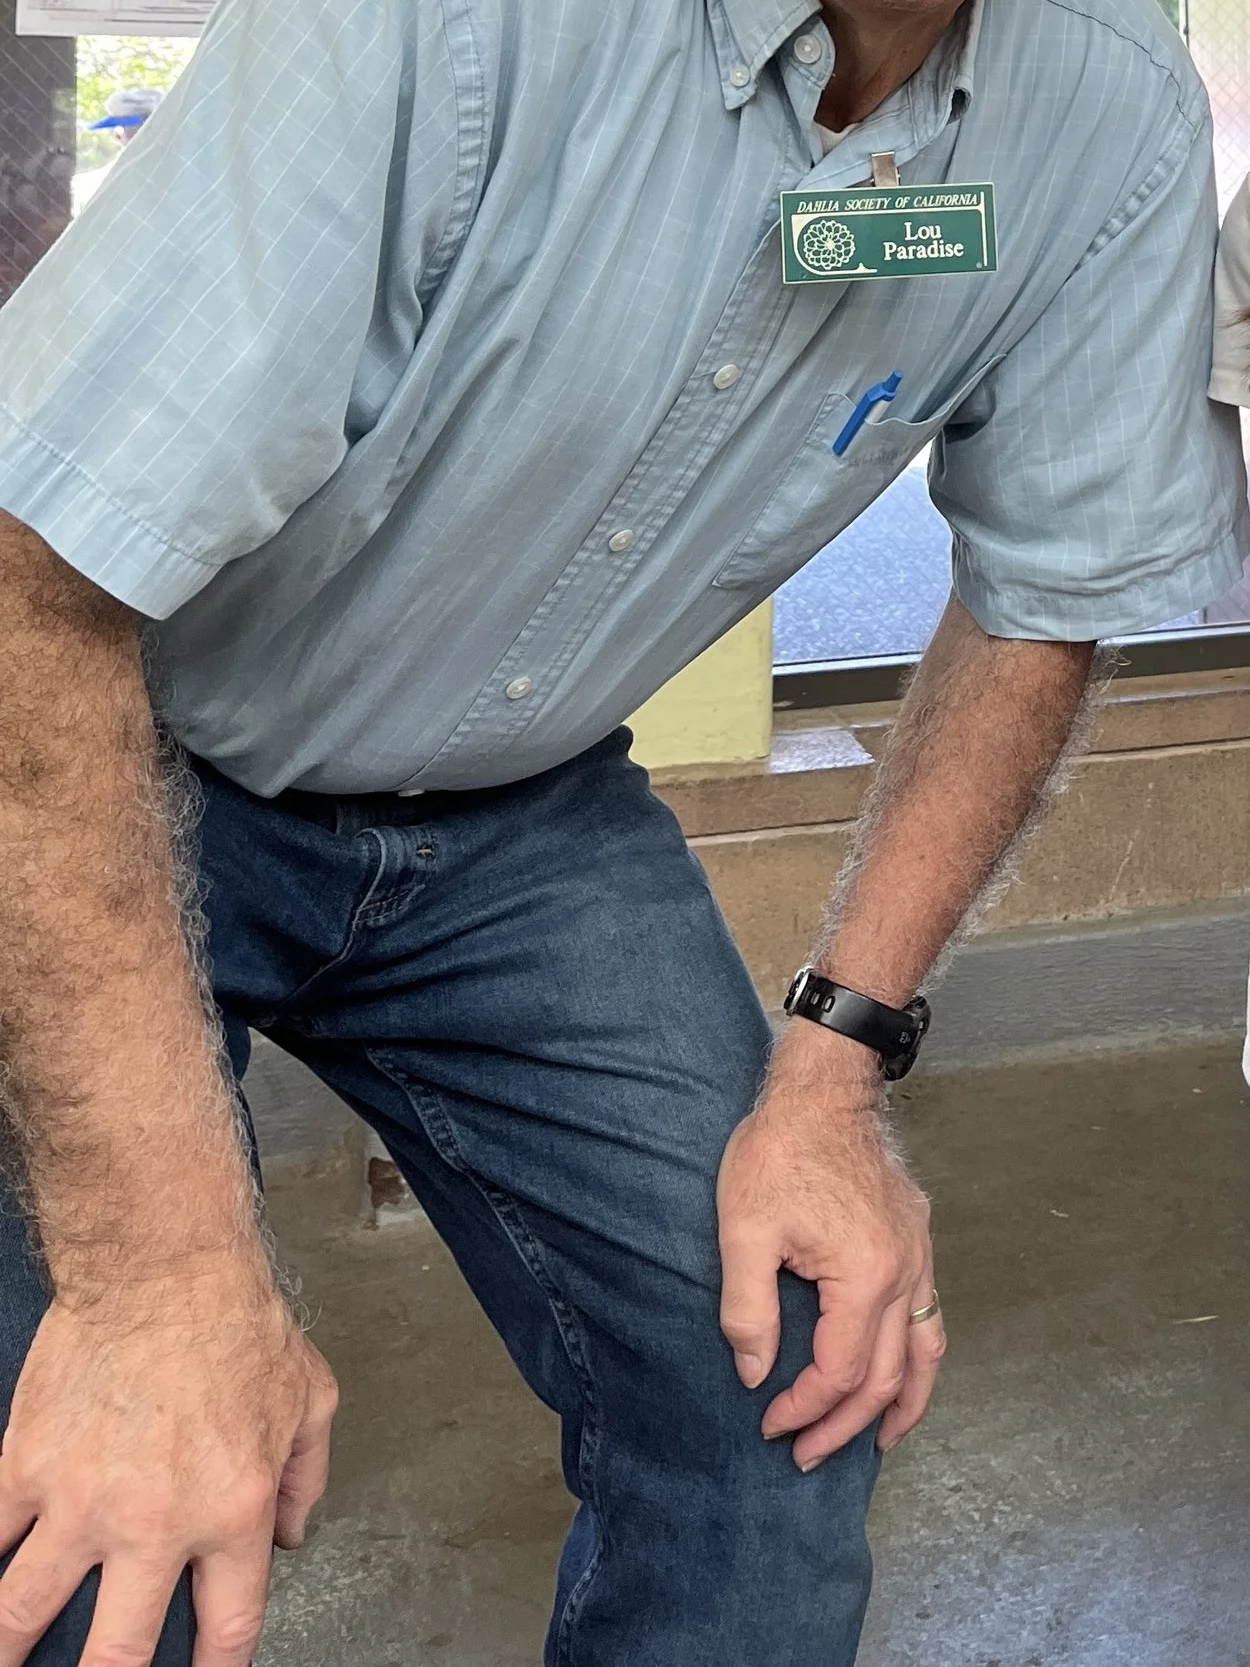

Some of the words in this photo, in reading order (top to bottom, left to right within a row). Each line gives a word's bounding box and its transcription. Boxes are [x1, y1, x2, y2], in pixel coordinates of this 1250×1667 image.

[797, 200, 839, 213] DAHLIA
[845, 197, 891, 211] SOCIETY
[895, 196, 910, 208] OF
[913, 193, 978, 207] CALIFORNIA
[904, 221, 942, 241] Lou
[883, 241, 964, 261] Paradise
